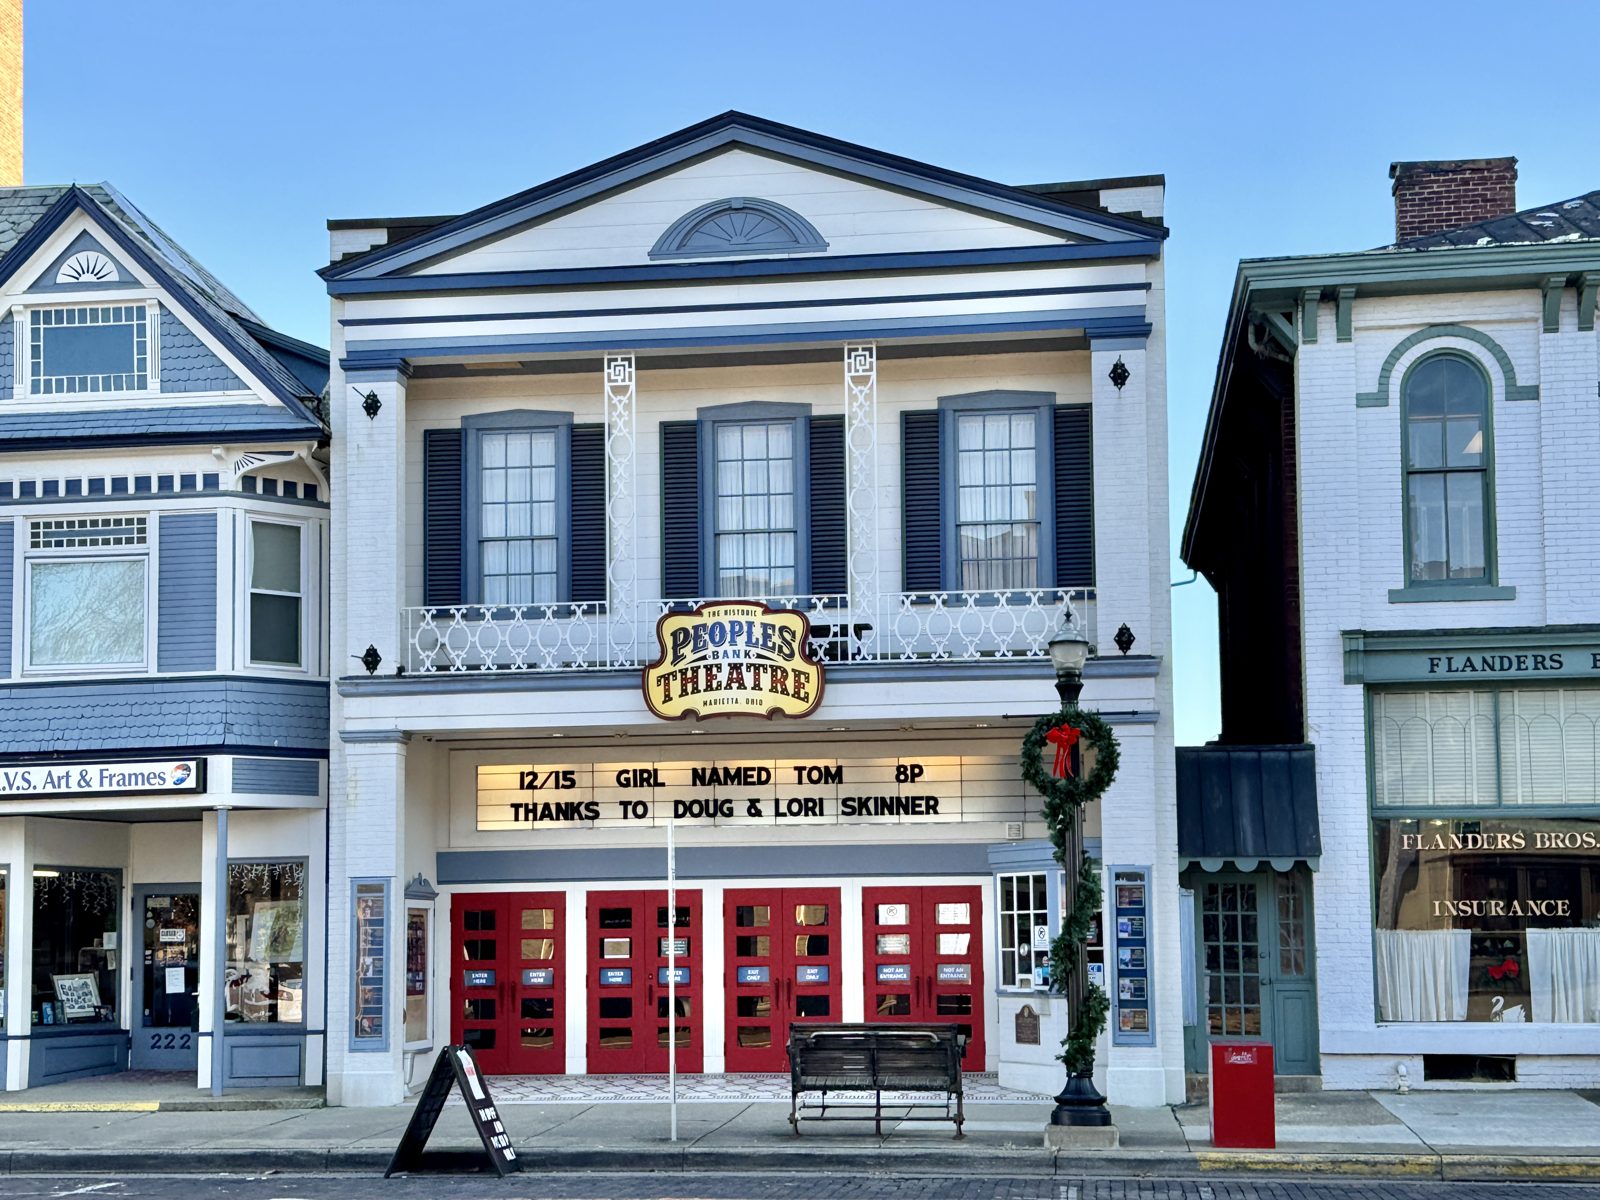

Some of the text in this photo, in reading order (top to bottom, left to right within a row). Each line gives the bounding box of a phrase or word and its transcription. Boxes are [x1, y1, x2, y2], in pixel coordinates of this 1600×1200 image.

[724, 609, 757, 617] HISTORIC
[670, 620, 797, 667] PEOPLES
[712, 649, 752, 660] BANK
[1428, 653, 1564, 674] FLANDERS
[656, 662, 810, 704] THEATRE
[745, 698, 763, 706] OHIO
[0, 768, 166, 792] .V.S. Art & Frames
[519, 764, 924, 790] 12/15 GIRL NAMED TOM 8P
[510, 795, 939, 821] THANKS TO DOUG & LORI SKINNER
[1401, 832, 1600, 850] FLANDERS BROS.
[1433, 900, 1571, 917] INSURANCE
[151, 1034, 191, 1050] 222
